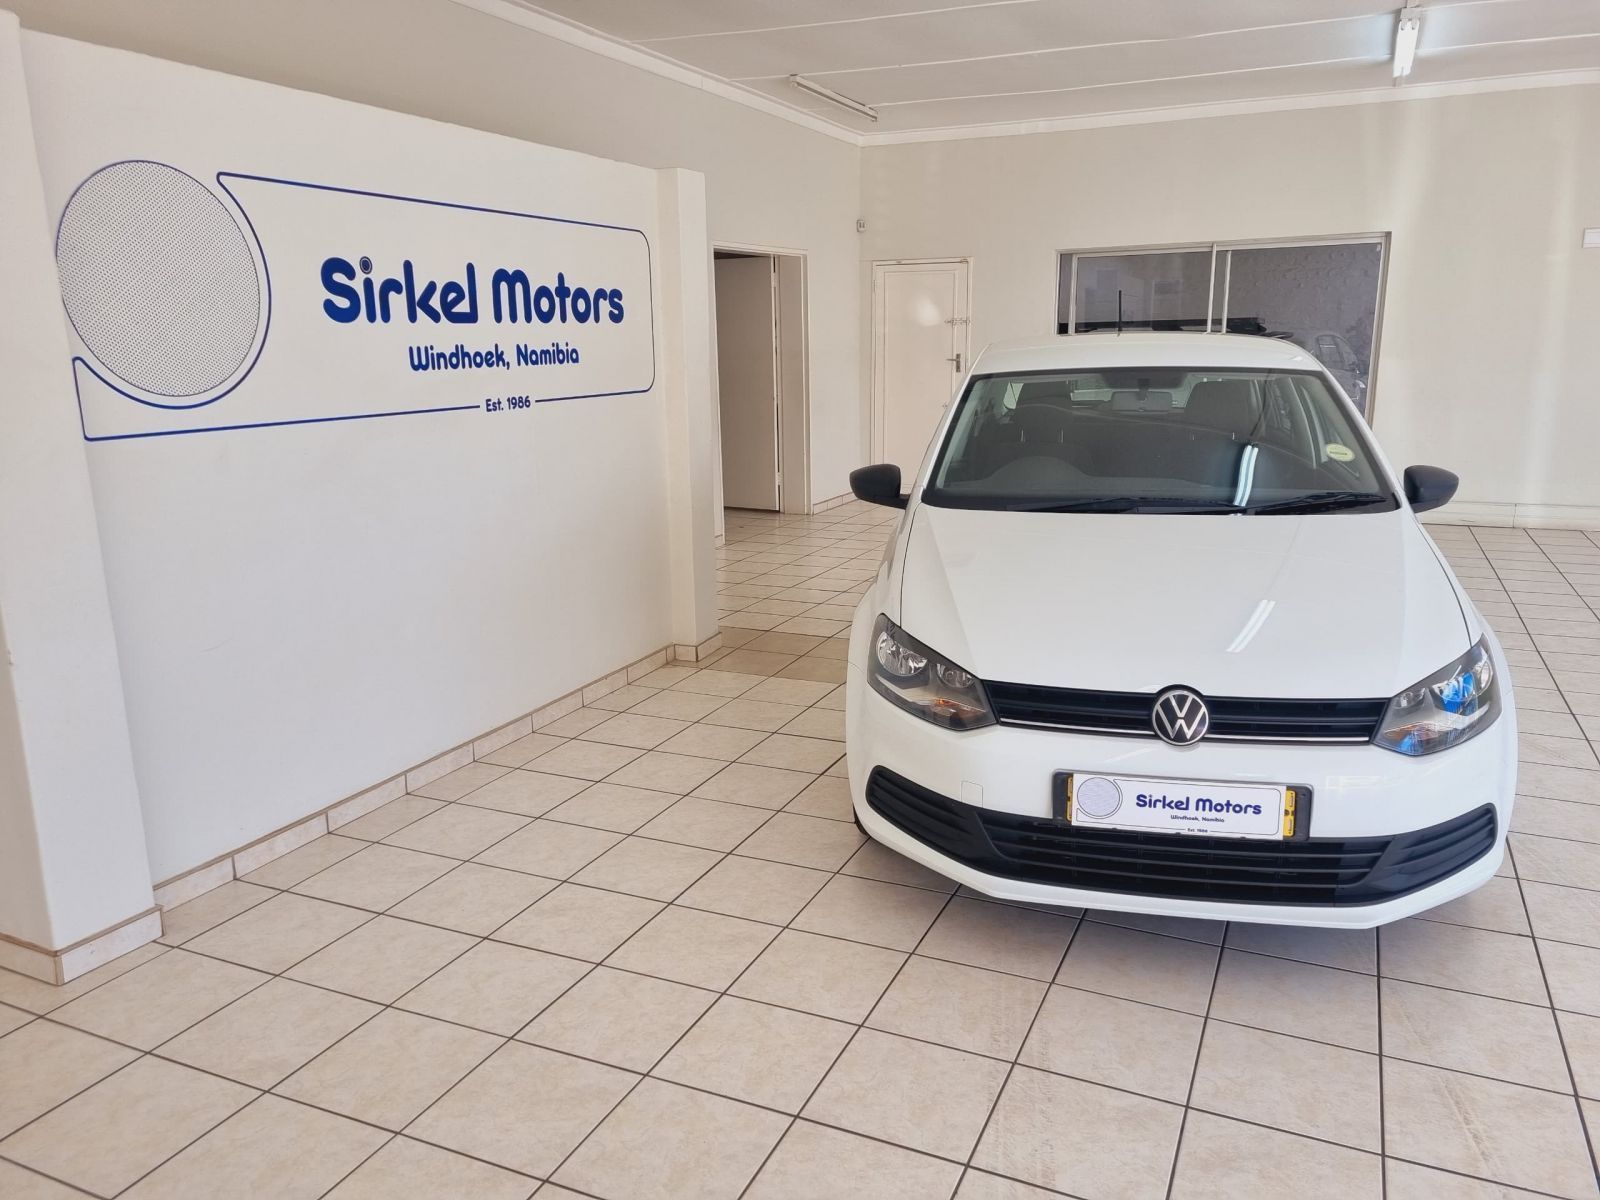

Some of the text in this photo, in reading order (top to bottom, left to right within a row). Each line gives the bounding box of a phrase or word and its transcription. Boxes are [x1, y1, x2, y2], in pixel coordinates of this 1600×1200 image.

[320, 256, 625, 324] Sirkel Motors
[408, 342, 579, 371] Windhoek, Namibia
[485, 395, 531, 412] Est. 1986
[1136, 794, 1262, 815] Sirkel Motors
